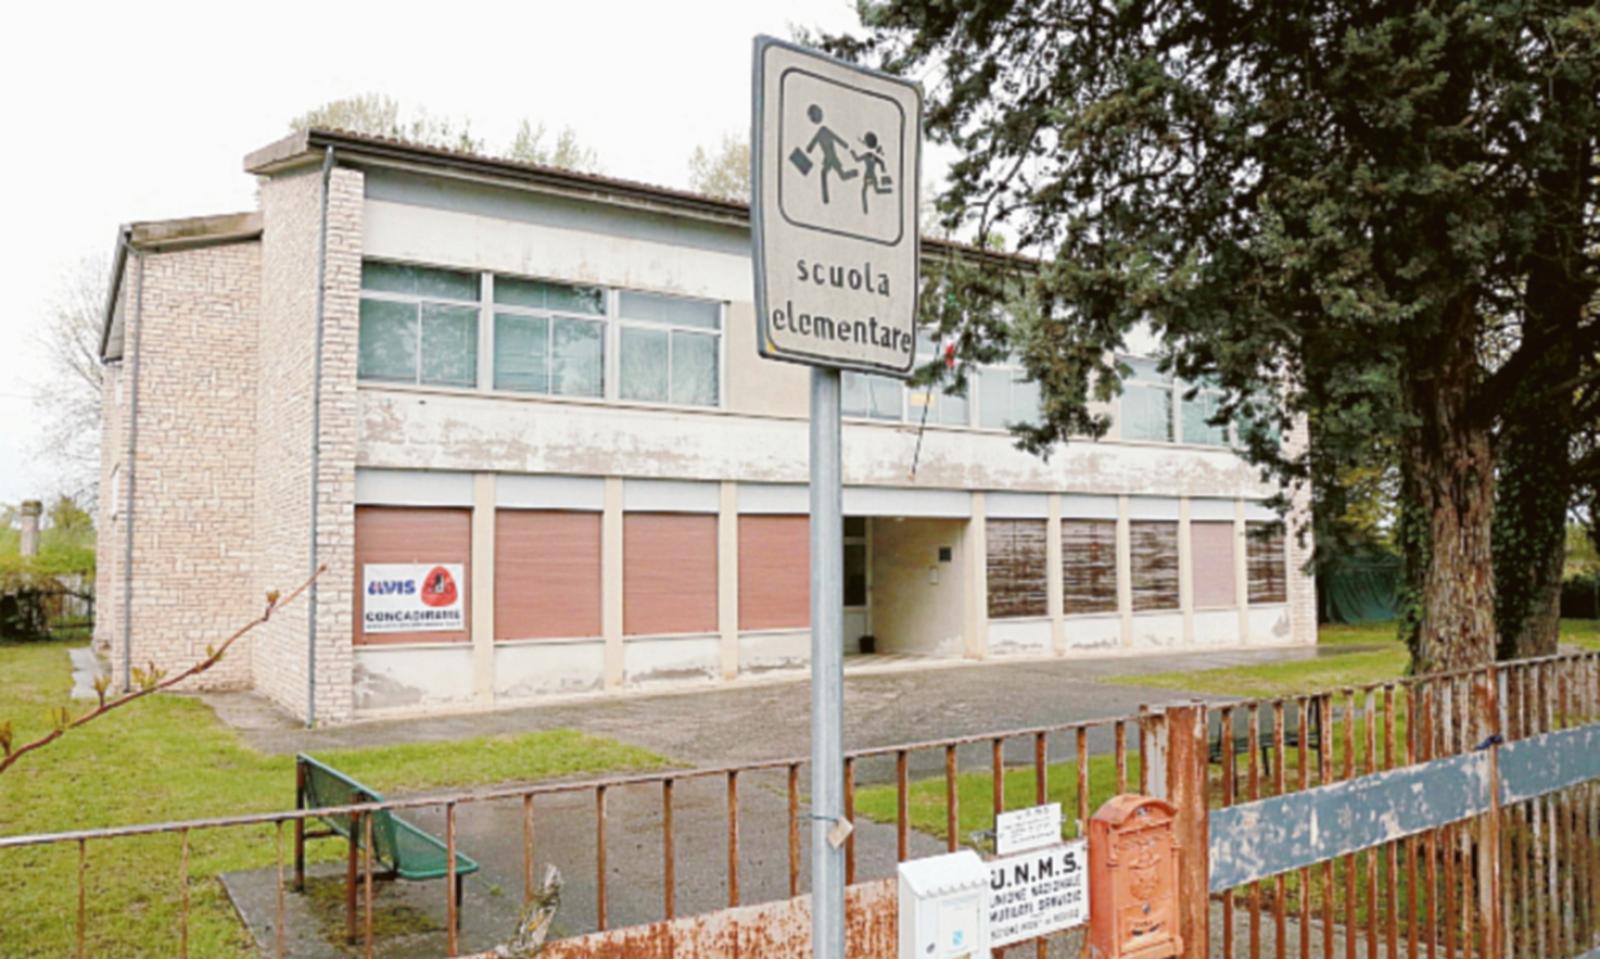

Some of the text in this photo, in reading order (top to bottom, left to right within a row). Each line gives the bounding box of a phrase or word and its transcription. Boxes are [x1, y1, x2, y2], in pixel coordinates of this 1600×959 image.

[797, 259, 890, 297] scuola
[772, 300, 912, 353] elementare
[990, 851, 1082, 890] U.N.M.S.
